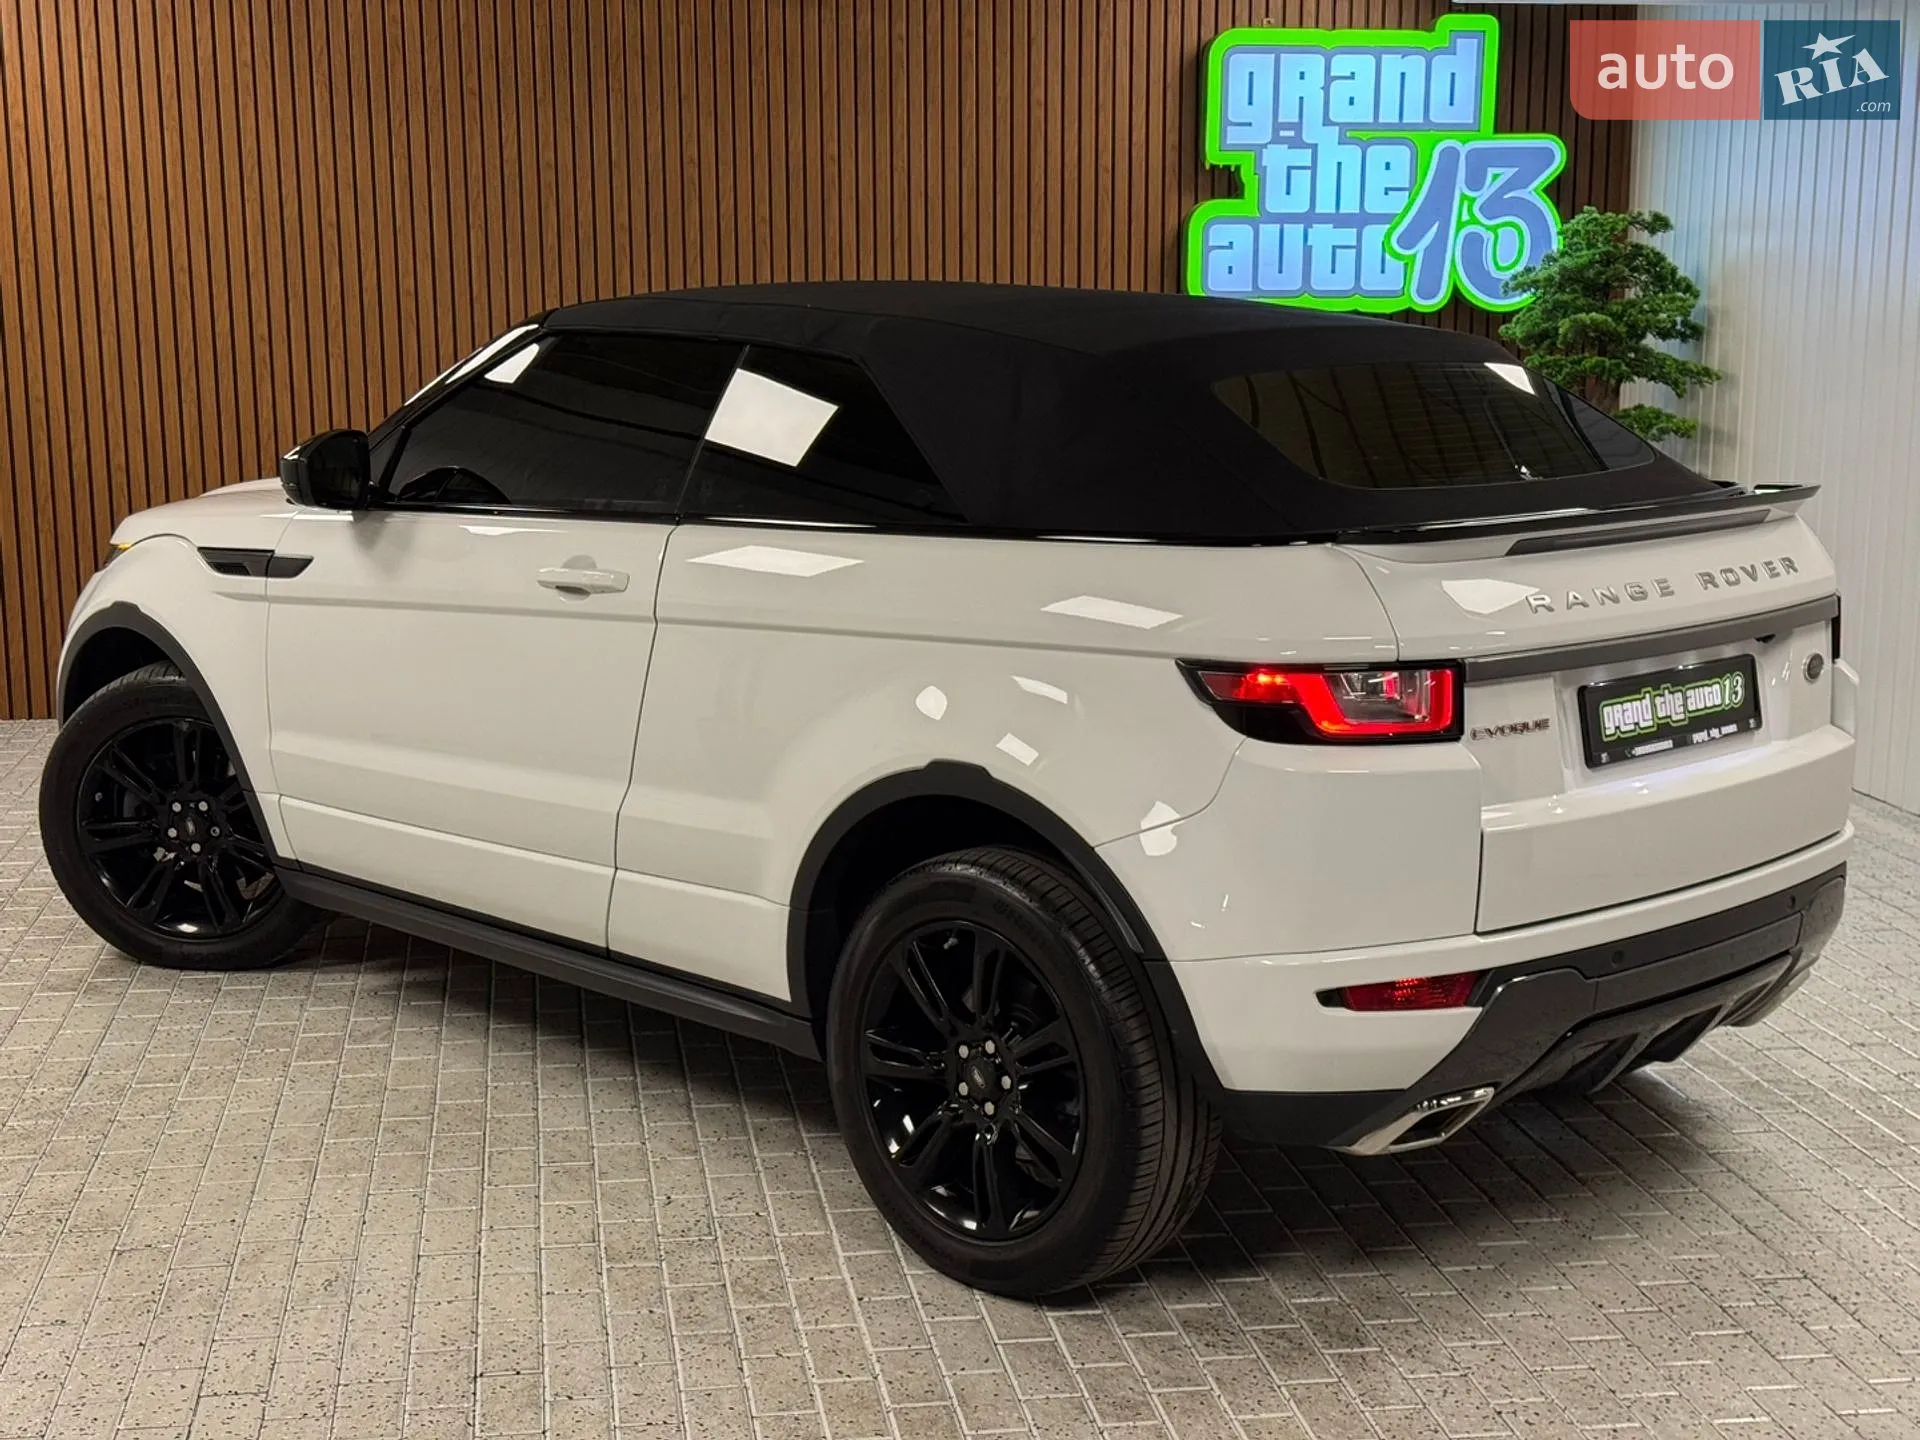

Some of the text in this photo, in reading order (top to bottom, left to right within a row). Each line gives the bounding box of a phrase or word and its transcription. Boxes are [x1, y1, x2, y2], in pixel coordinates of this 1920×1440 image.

[1226, 38, 1479, 145] grand
[1262, 127, 1411, 214] the
[1208, 139, 1565, 305] auto 13
[1525, 556, 1799, 614] RANGE ROVER
[1470, 718, 1550, 741] EVOQUE
[1602, 693, 1653, 735] grand
[1655, 689, 1685, 721] the
